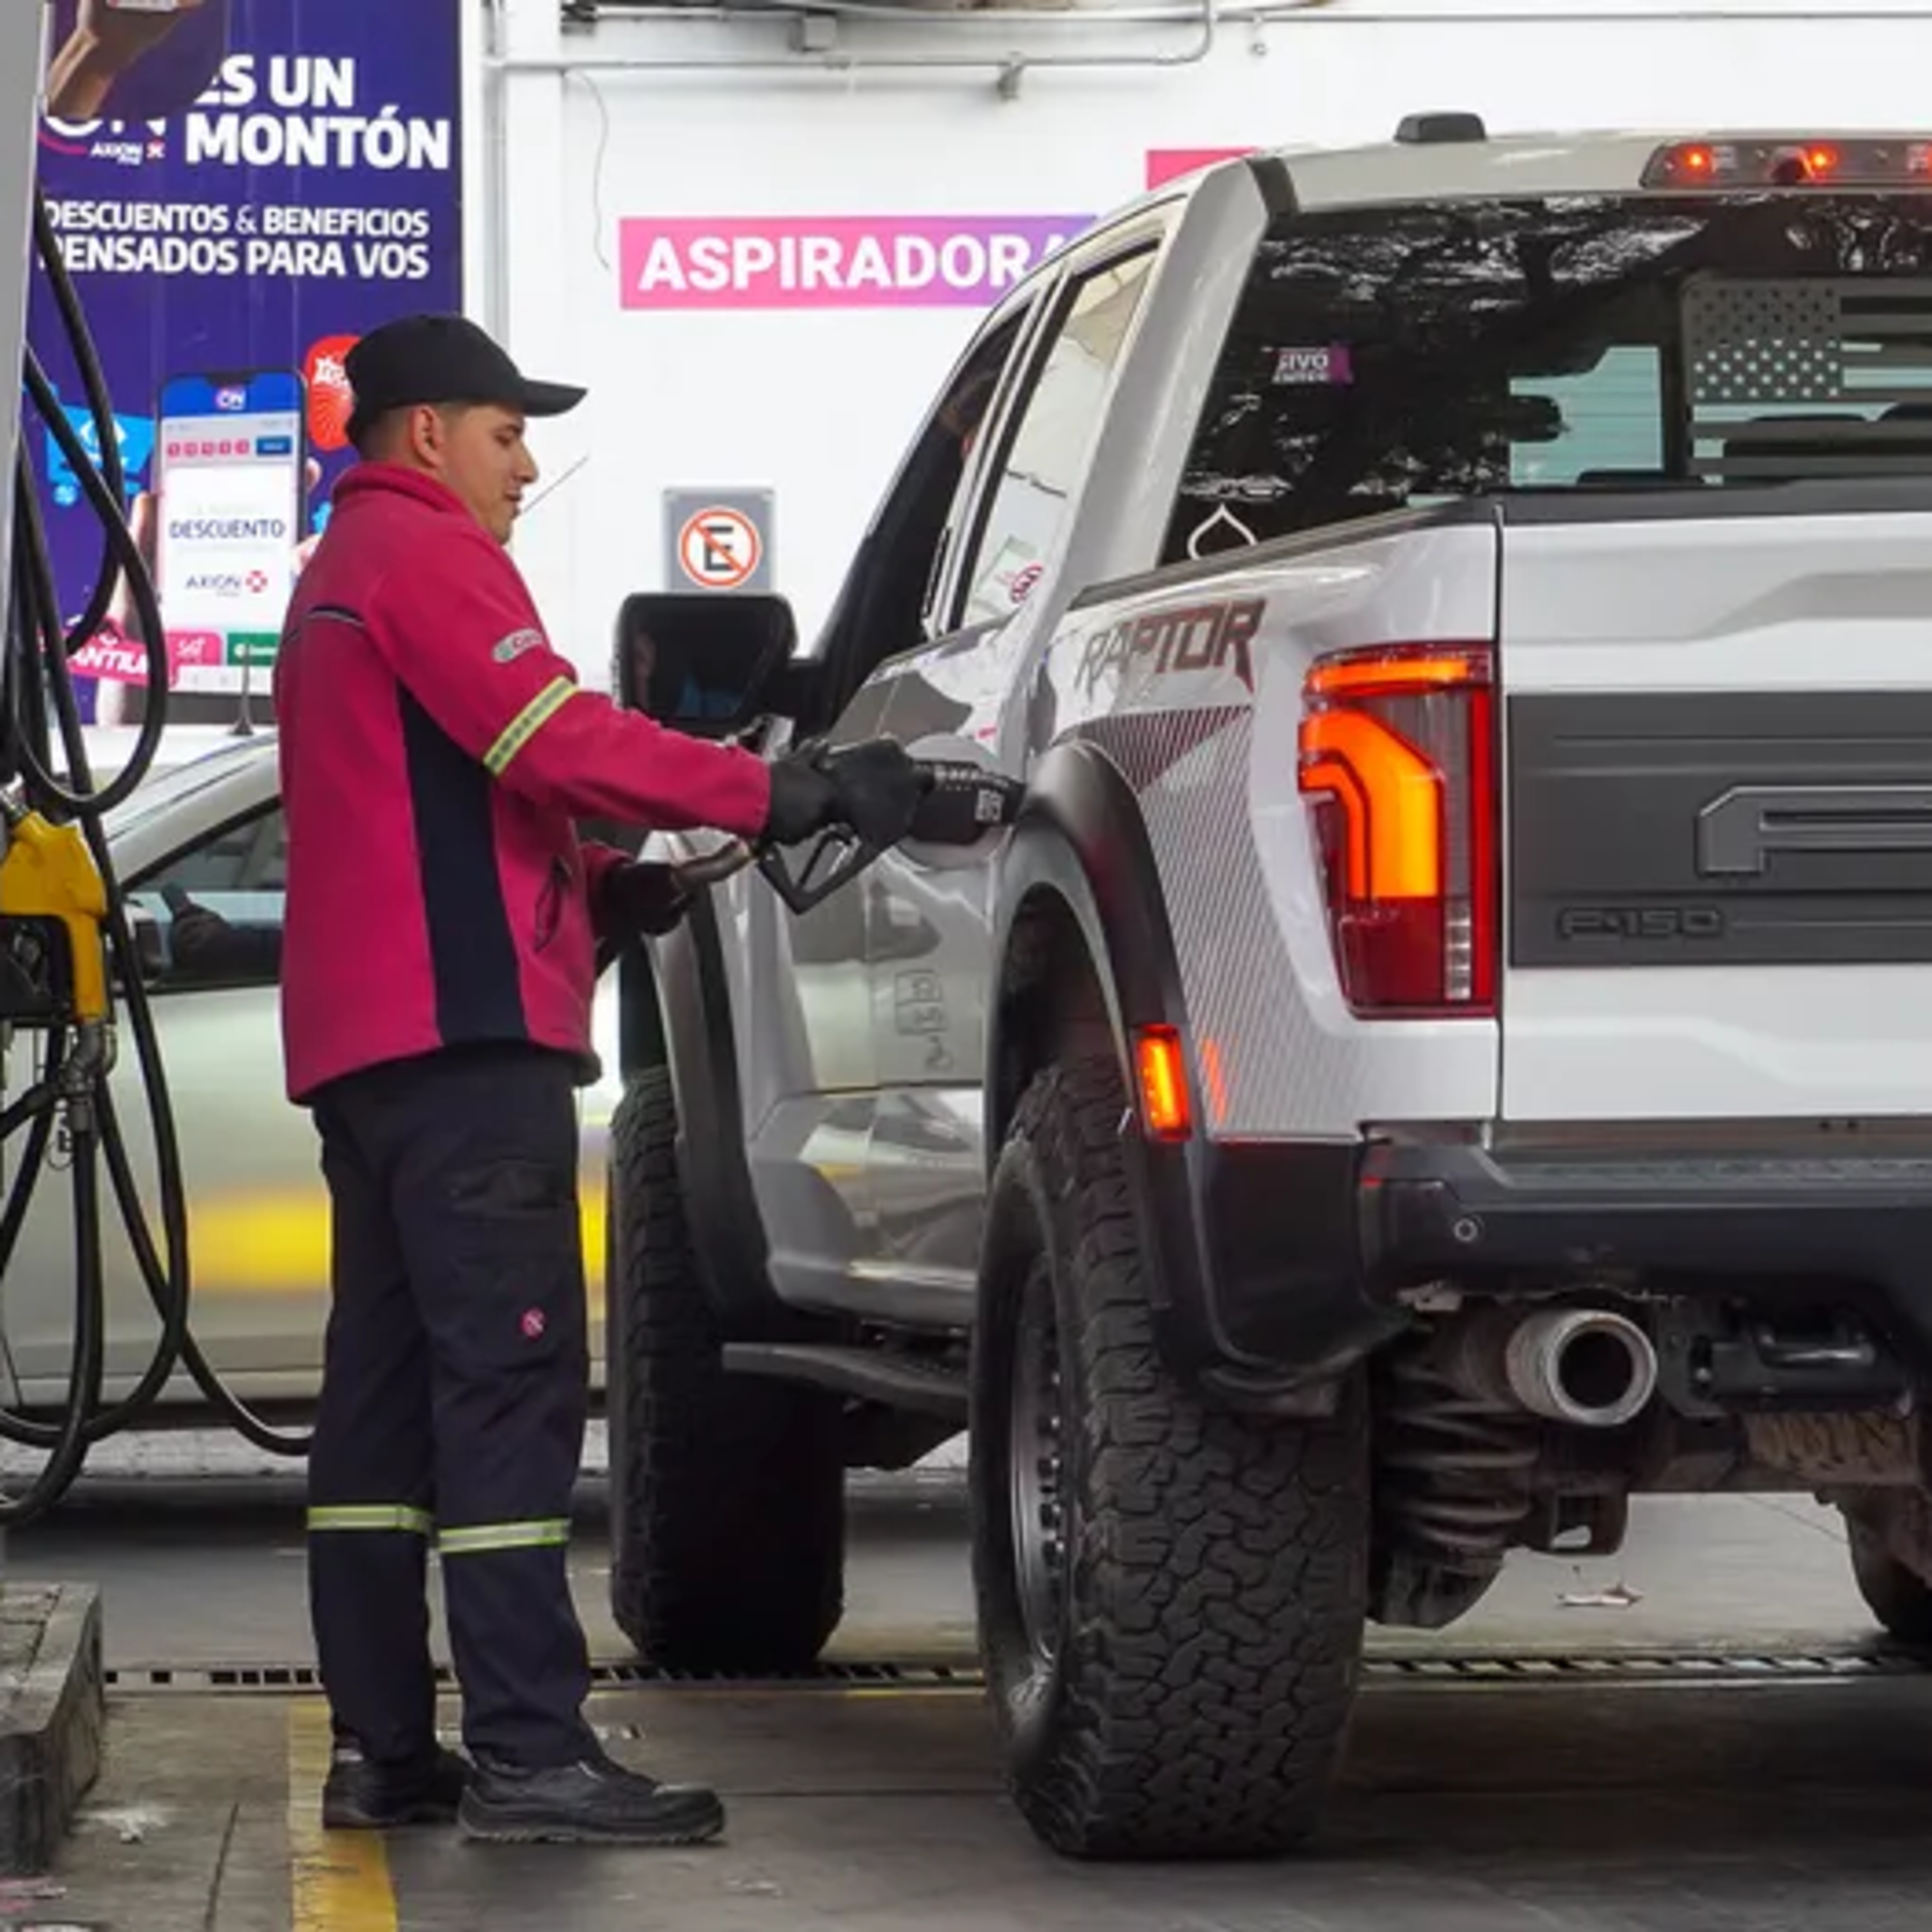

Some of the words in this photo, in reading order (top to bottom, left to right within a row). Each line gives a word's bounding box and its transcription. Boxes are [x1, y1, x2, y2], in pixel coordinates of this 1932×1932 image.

[270, 57, 354, 108] UN
[186, 106, 450, 169] MONTÓN
[43, 200, 229, 232] DESCUENTOS
[235, 204, 257, 234] &
[263, 205, 430, 238] BENEFICIOS
[246, 241, 346, 276] PARA
[354, 242, 430, 279] VOS
[639, 234, 1064, 291] ASPIRADOR
[169, 519, 287, 538] DESCUENTO
[1074, 597, 1267, 701] RAPTOR
